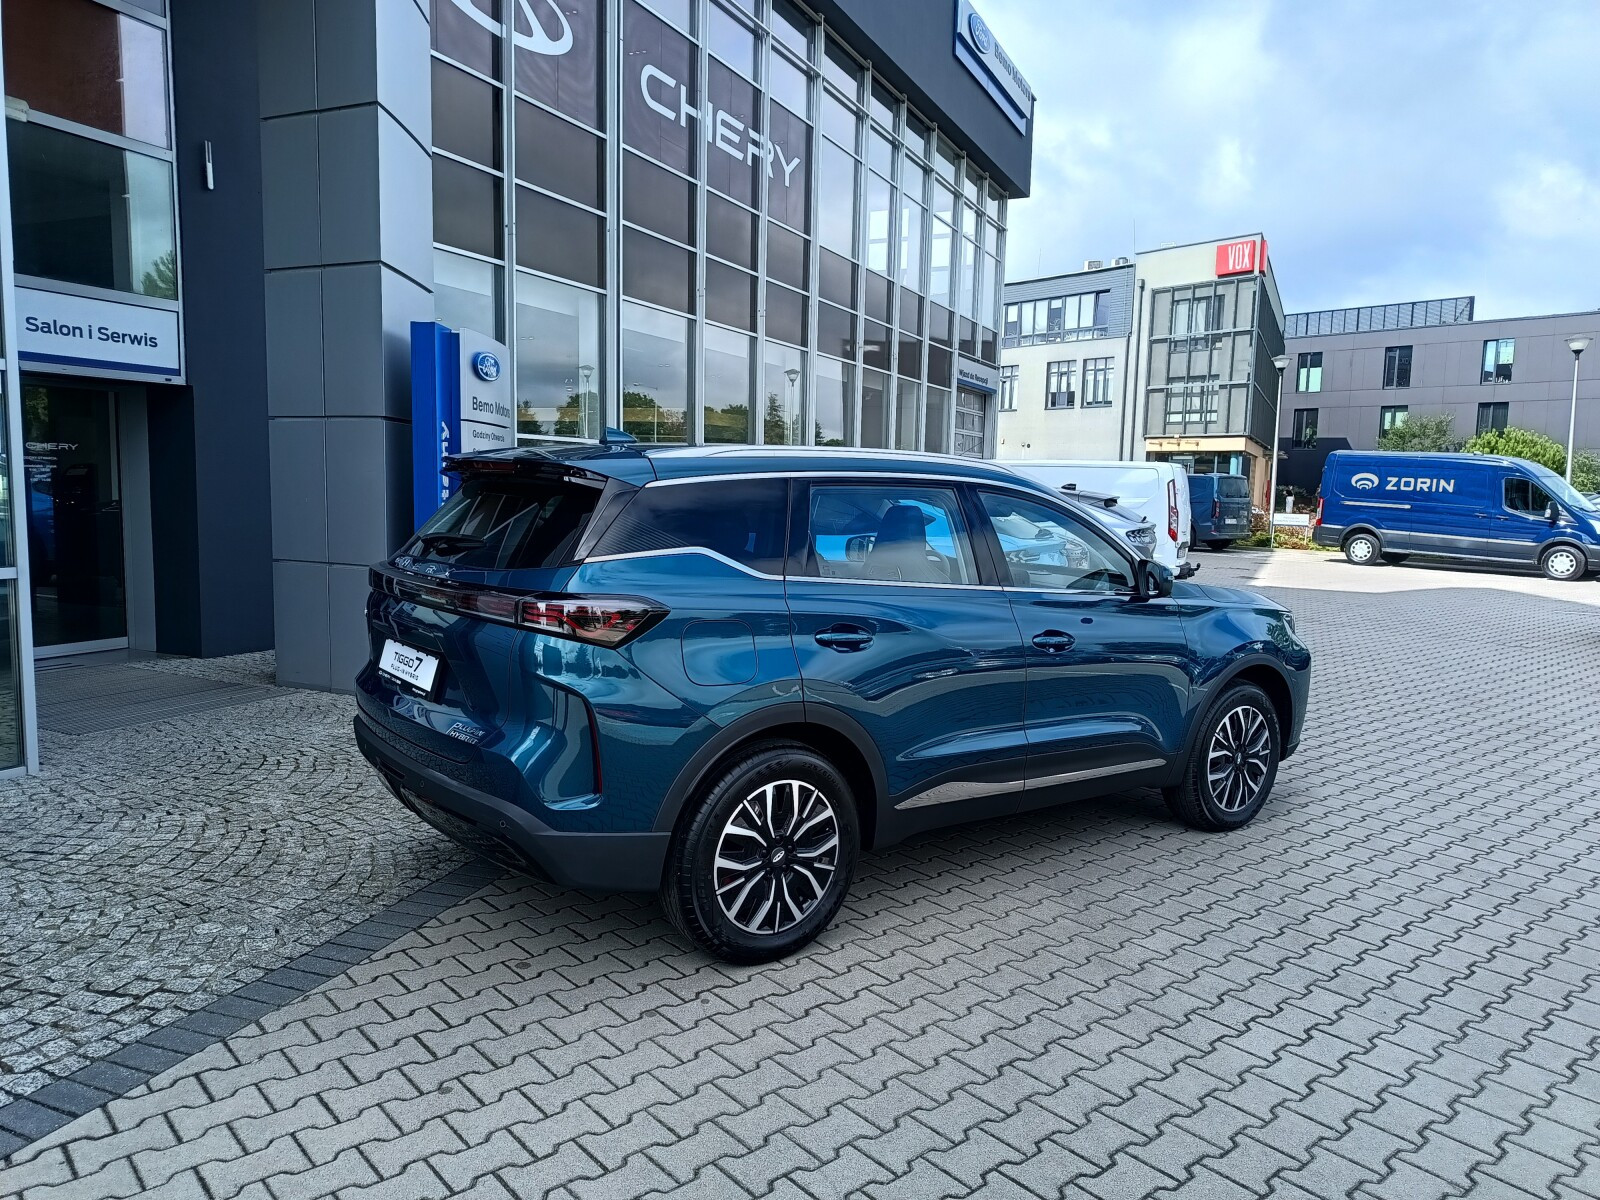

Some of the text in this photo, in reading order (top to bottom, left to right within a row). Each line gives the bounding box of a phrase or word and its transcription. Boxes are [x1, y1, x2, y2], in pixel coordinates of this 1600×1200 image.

[994, 42, 1031, 101] Bemo Motors
[640, 64, 801, 188] CHERY
[1228, 242, 1251, 271] VOX
[25, 316, 158, 348] Salon i Serwis
[472, 396, 511, 418] Bemo Motors
[25, 441, 79, 451] CHERY
[472, 429, 491, 441] Godziny
[1385, 477, 1455, 493] ZORIN
